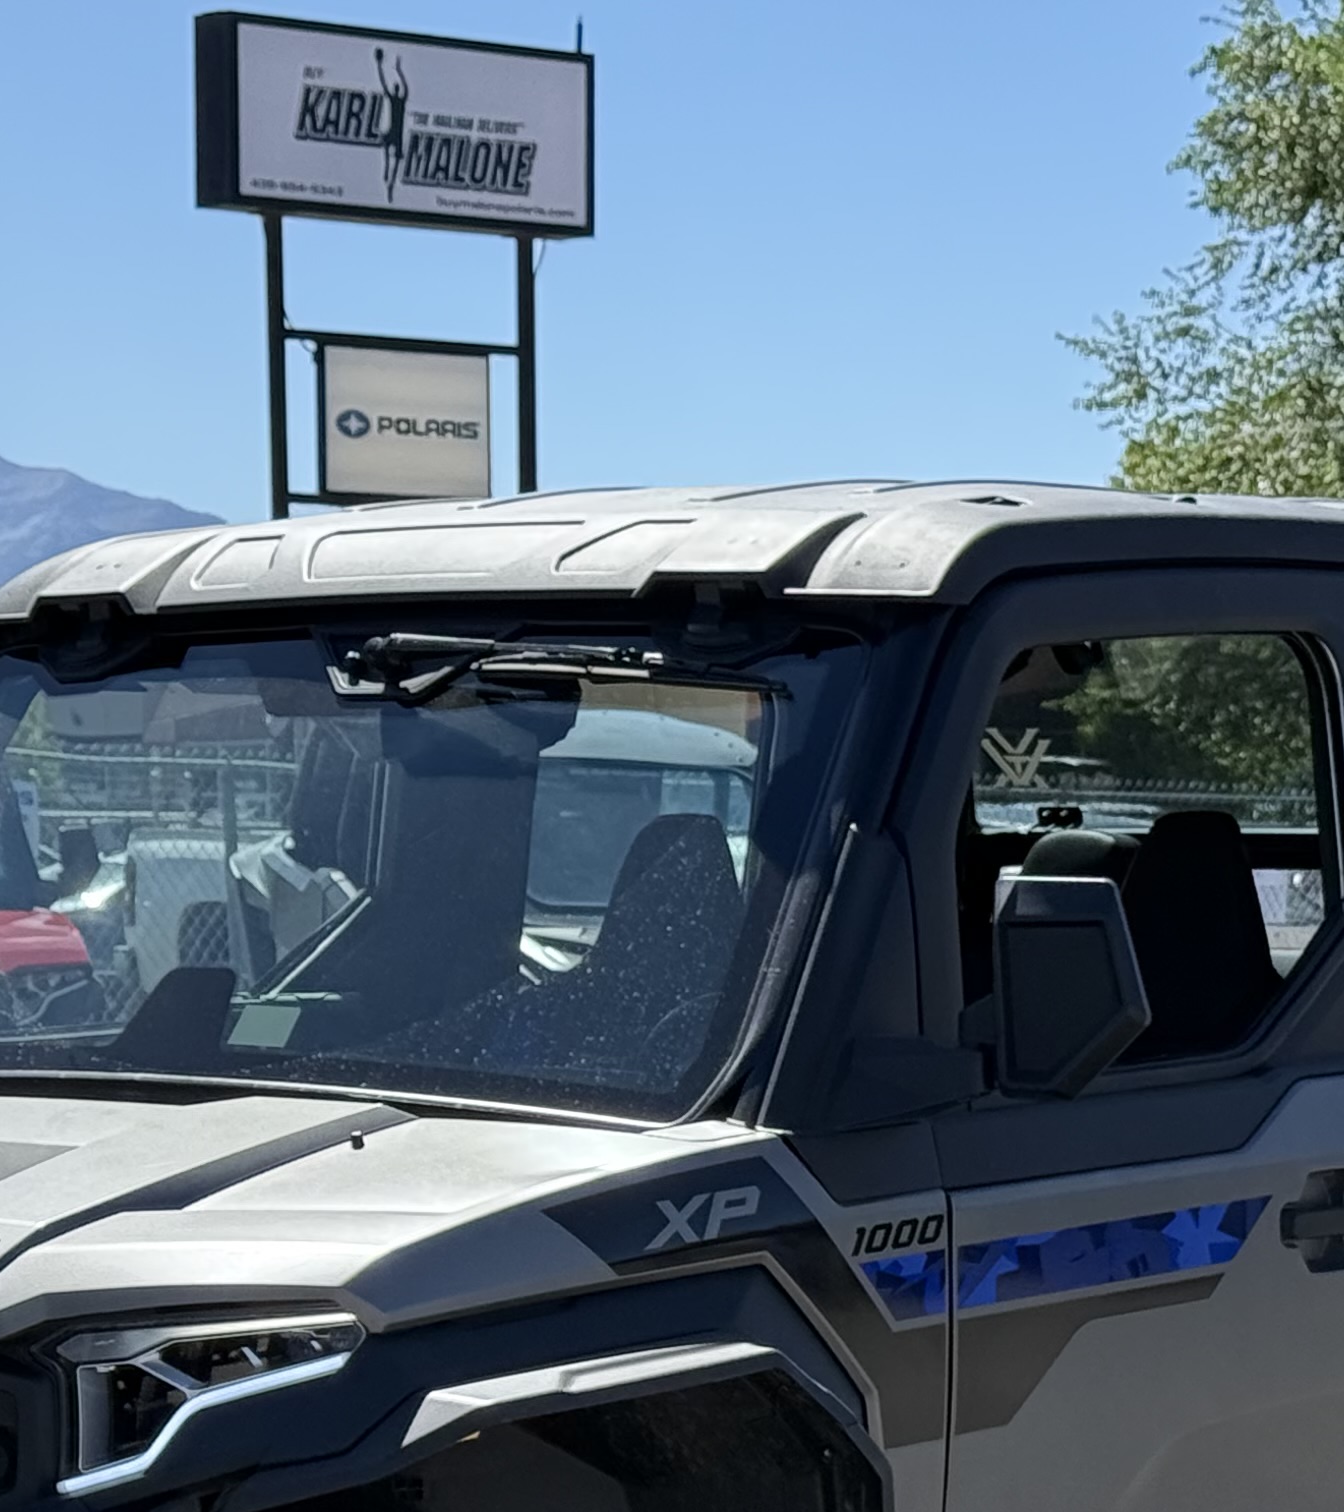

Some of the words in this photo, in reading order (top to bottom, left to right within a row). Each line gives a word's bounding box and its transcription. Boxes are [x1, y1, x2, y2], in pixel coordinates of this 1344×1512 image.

[294, 85, 383, 146] KARL
[402, 130, 537, 196] MALONE
[377, 415, 480, 440] POLARIS
[643, 1185, 761, 1251] XP
[851, 1213, 945, 1257] 1000
